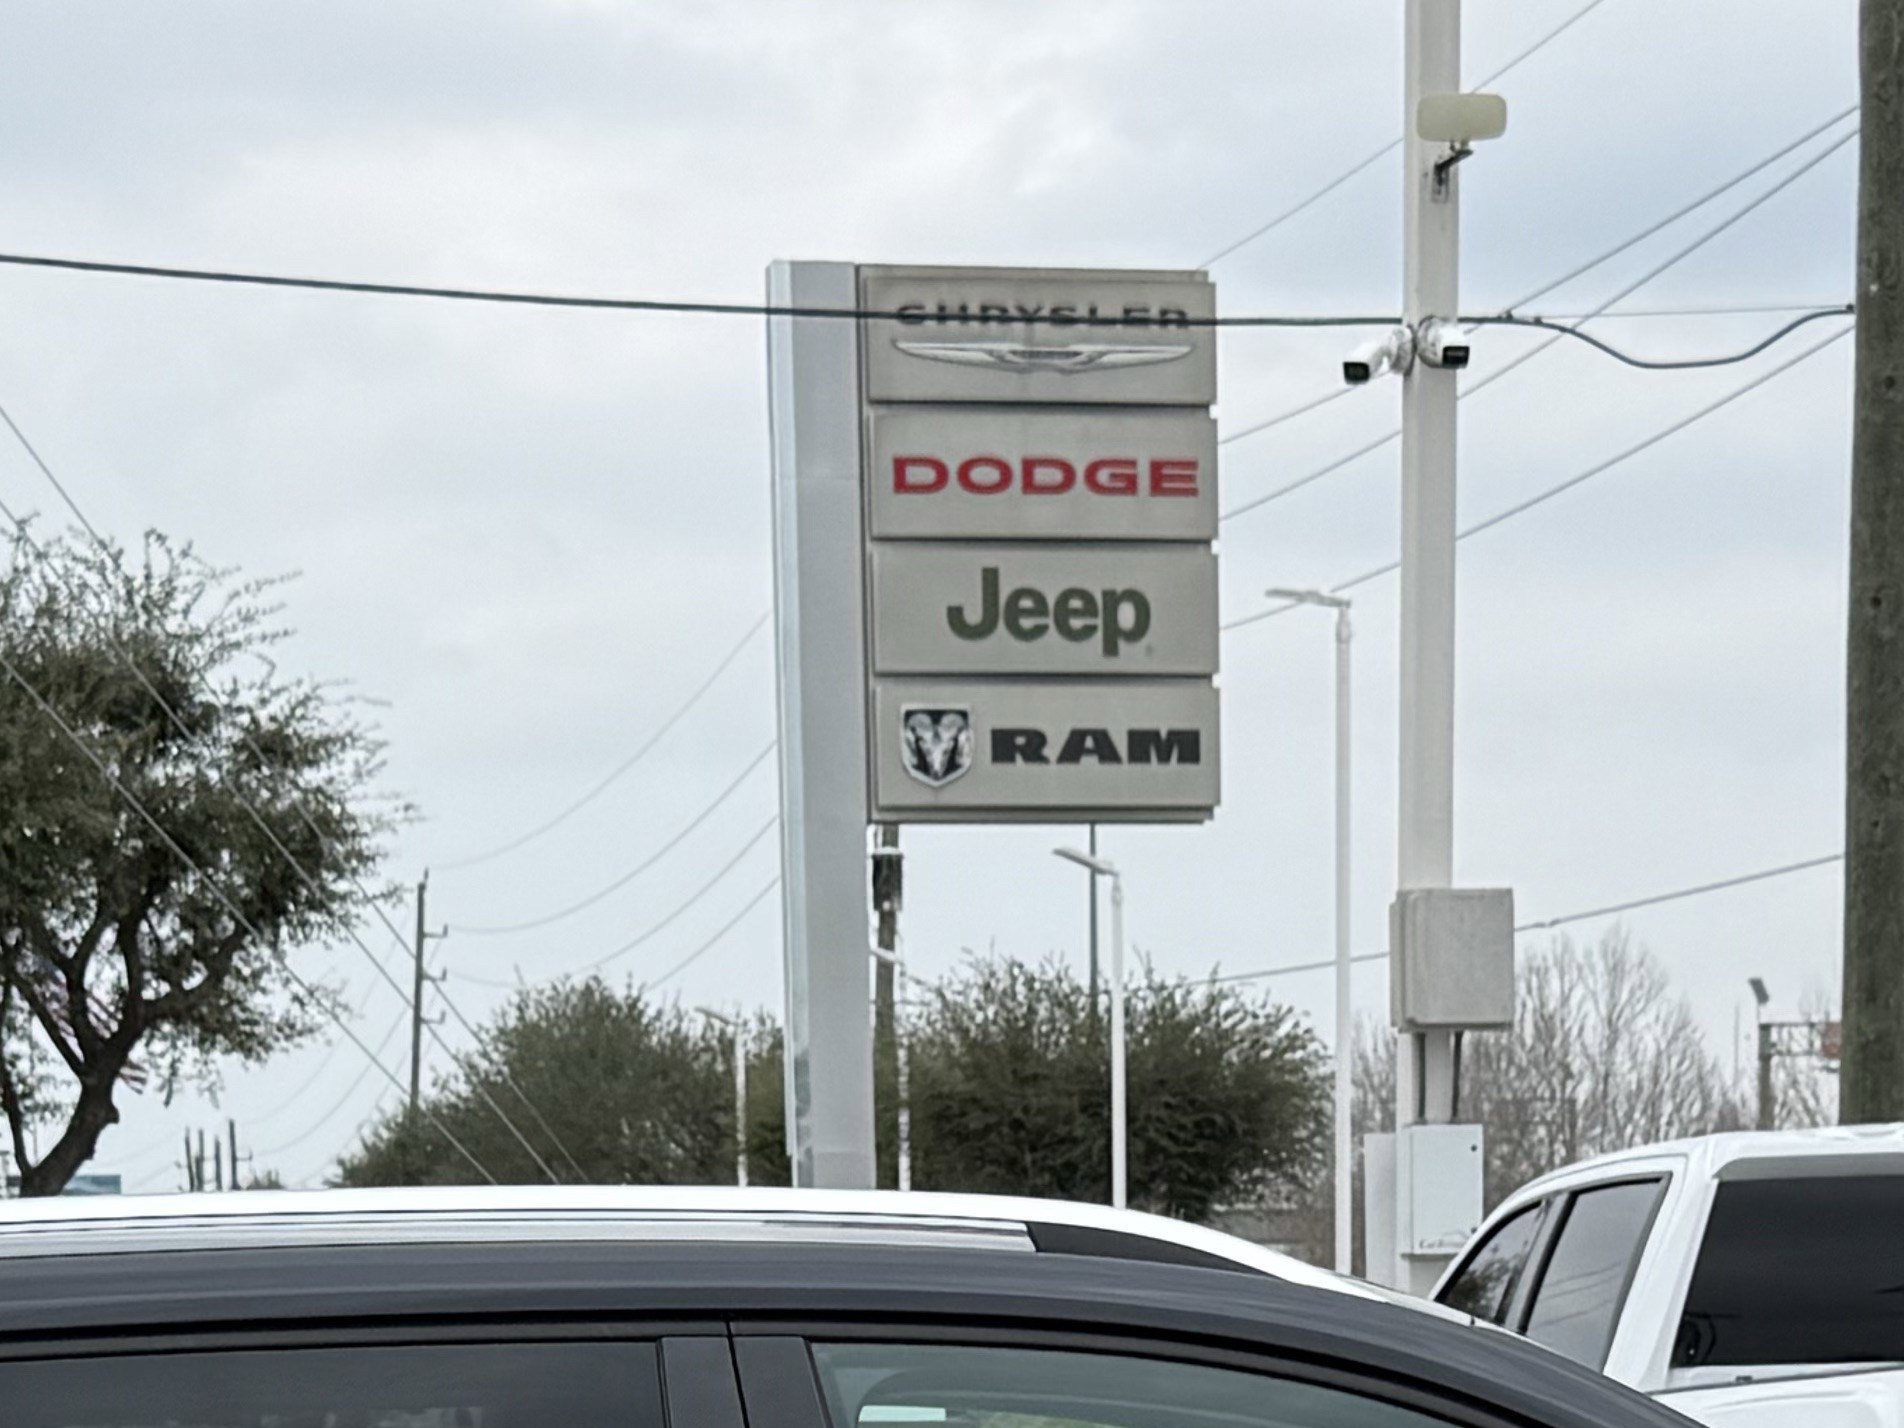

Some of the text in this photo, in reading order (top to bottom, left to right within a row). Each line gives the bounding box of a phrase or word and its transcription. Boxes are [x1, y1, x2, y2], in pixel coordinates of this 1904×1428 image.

[892, 456, 1200, 497] DODGE
[946, 566, 1152, 657] Jeep
[990, 727, 1202, 765] RAM
